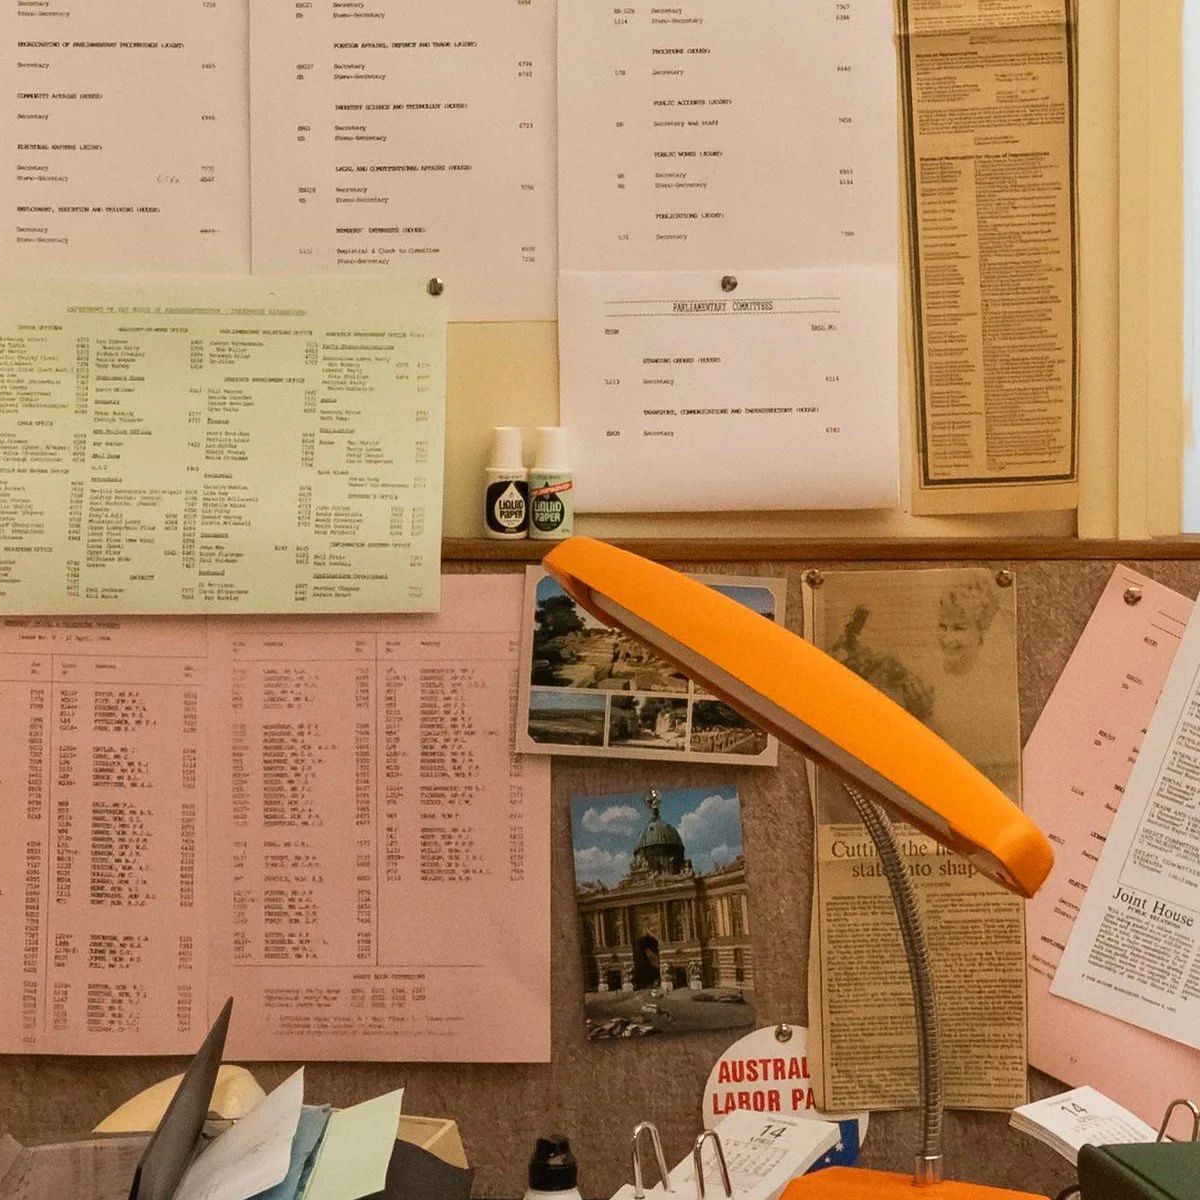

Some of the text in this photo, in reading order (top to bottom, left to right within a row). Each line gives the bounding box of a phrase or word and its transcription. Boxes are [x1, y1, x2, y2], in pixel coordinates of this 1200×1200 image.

[673, 301, 726, 312] PARLIAMENTARY
[499, 500, 523, 510] LIQUID
[535, 501, 561, 512] LIQUID
[902, 840, 927, 856] the
[1110, 885, 1196, 929] Joint House
[1126, 905, 1147, 917] PUBLIC
[1060, 1102, 1088, 1116] 14
[759, 1125, 787, 1138] 14
